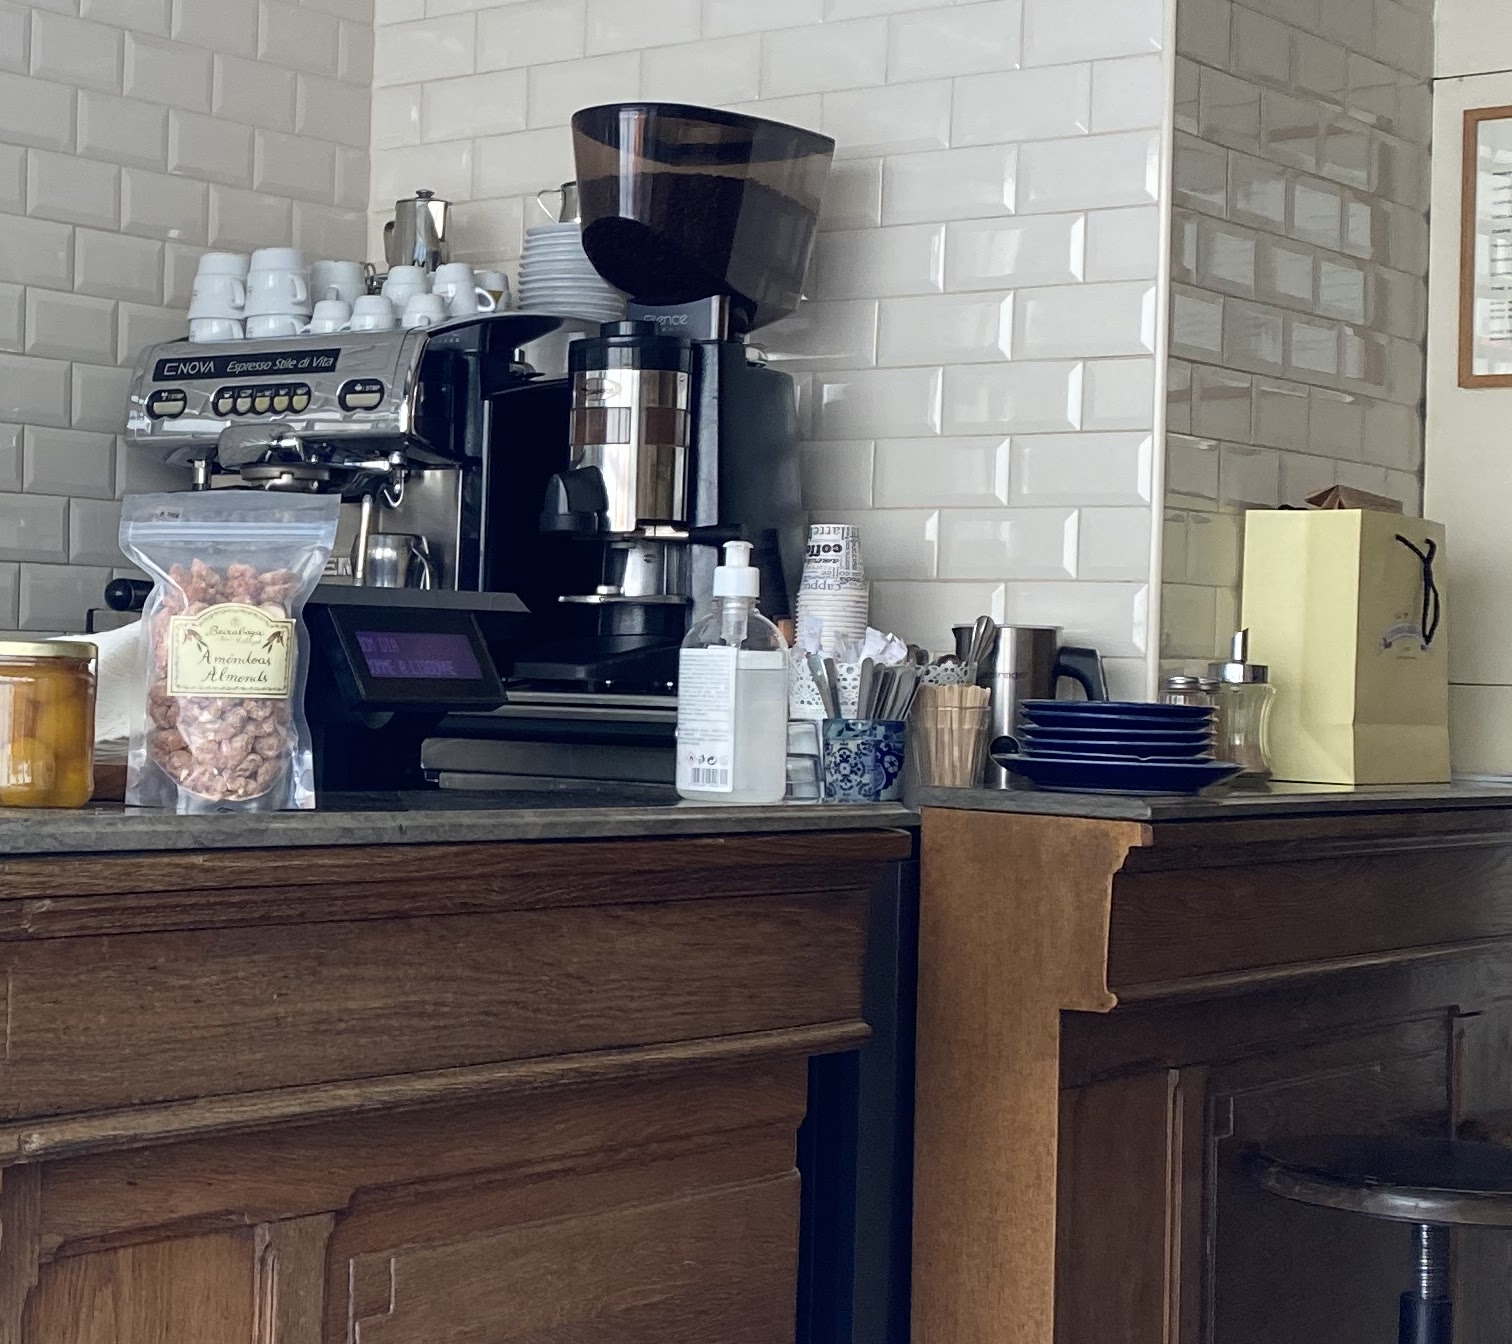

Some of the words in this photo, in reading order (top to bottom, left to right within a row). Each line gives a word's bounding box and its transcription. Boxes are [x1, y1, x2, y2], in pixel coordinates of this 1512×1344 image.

[226, 359, 273, 375] Espresso
[273, 357, 297, 371] Stile
[298, 356, 310, 368] di
[312, 355, 335, 367] Vita
[201, 665, 269, 683] Almonds
